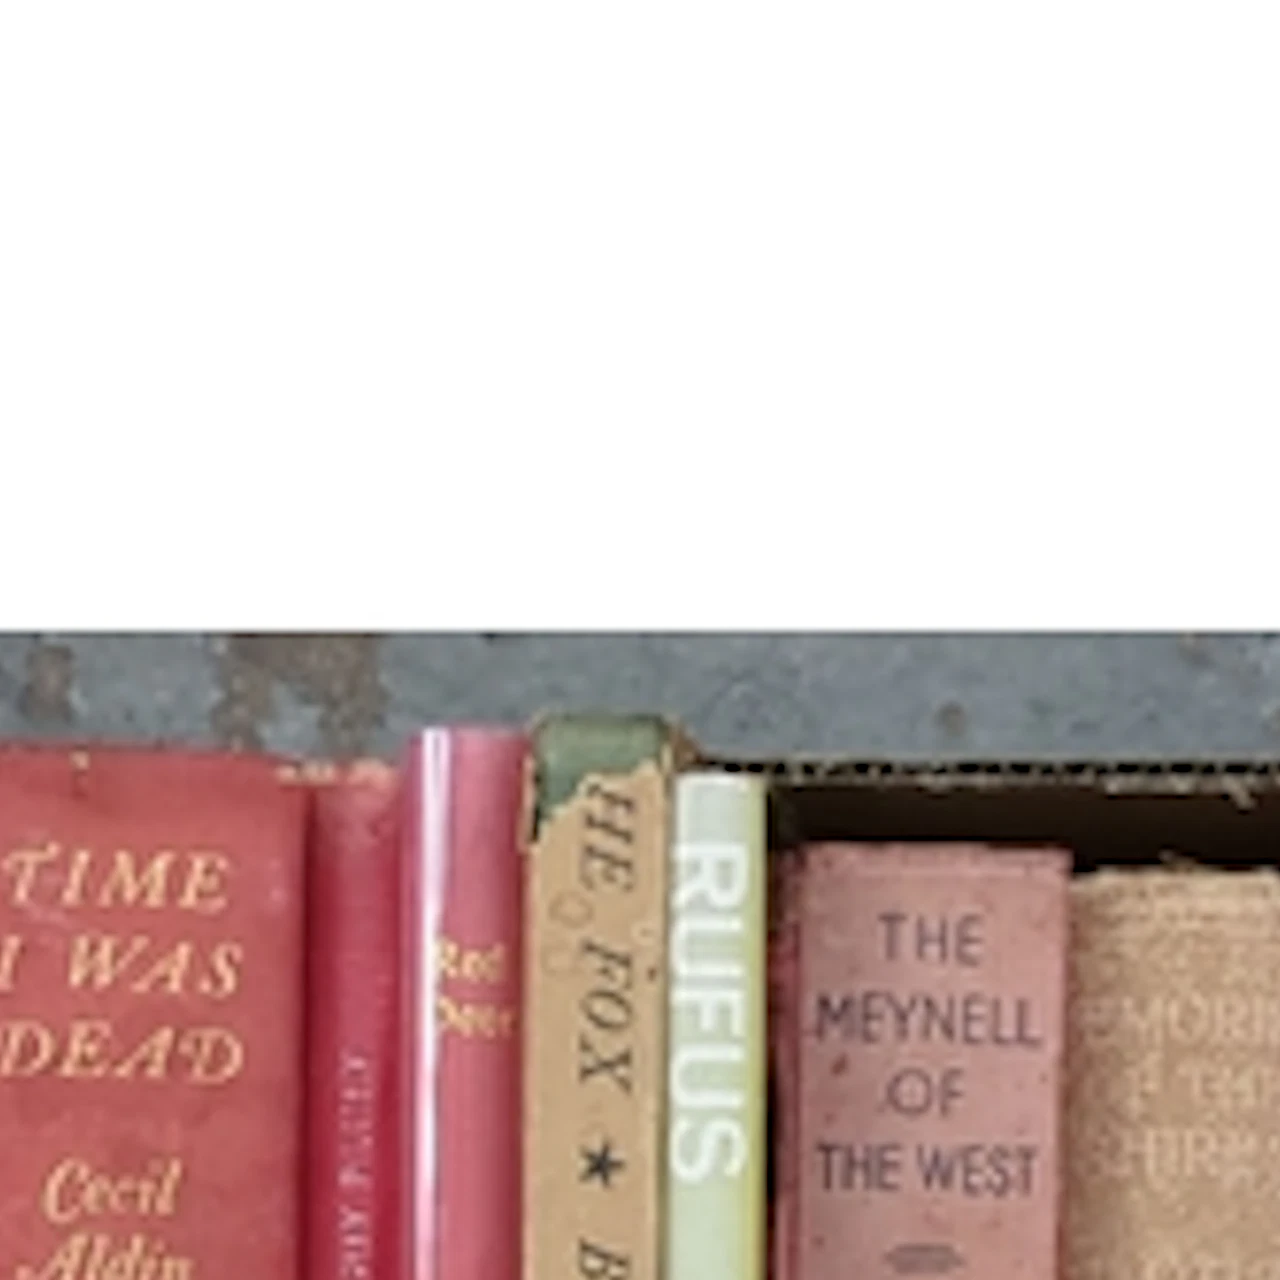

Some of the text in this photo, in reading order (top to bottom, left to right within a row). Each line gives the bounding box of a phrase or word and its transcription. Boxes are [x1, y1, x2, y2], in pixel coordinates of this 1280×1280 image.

[580, 778, 636, 894] HE
[66, 934, 245, 998] WAS
[433, 939, 507, 986] Red
[876, 911, 986, 967] THE
[577, 938, 634, 1097] FOX
[668, 842, 750, 1185] RUFUS
[813, 992, 1044, 1050] MEYNELL
[883, 1066, 966, 1118] OF
[40, 1156, 184, 1226] Cecil
[816, 1142, 1042, 1199] THE WEST
